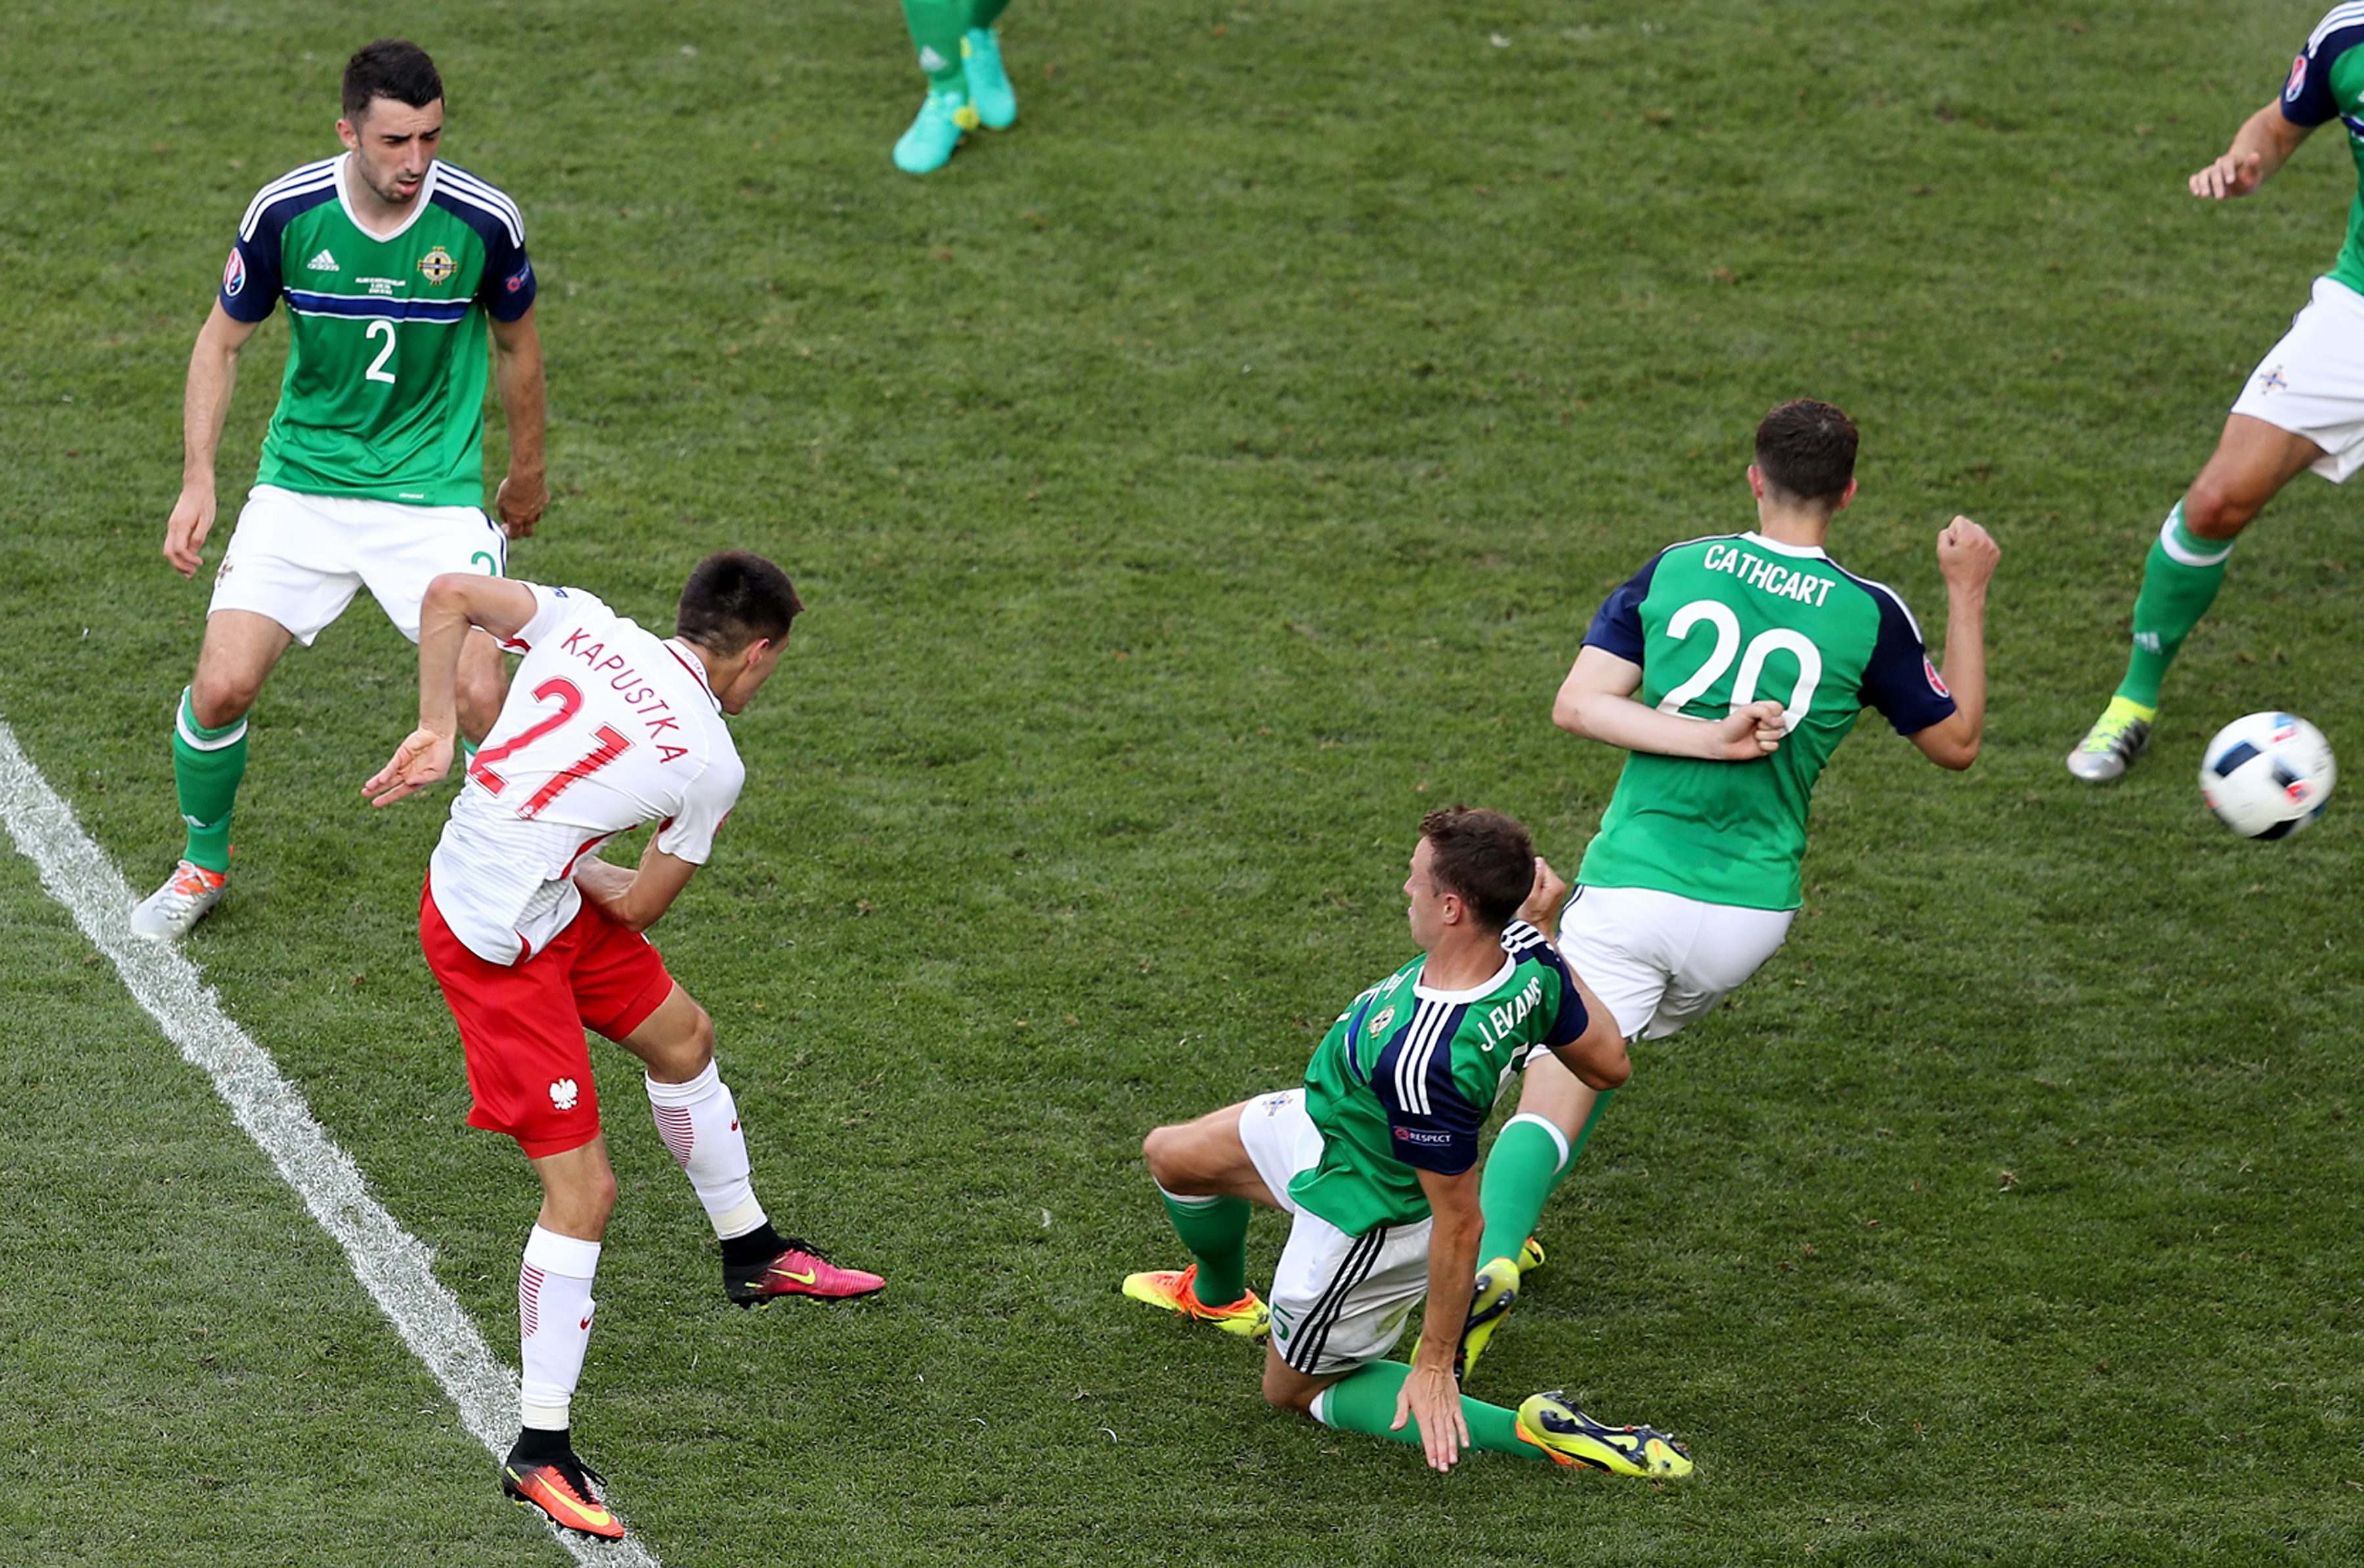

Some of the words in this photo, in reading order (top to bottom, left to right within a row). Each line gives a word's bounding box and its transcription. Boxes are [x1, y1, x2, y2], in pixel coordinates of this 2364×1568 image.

[365, 320, 396, 383] 2
[1704, 544, 1836, 607] CATHCART
[561, 628, 688, 763] KAPUSTKA
[1655, 599, 1822, 738] 20
[465, 676, 636, 820] 21
[1410, 1133, 1452, 1143] RESPECT
[1272, 1302, 1294, 1340] 5
